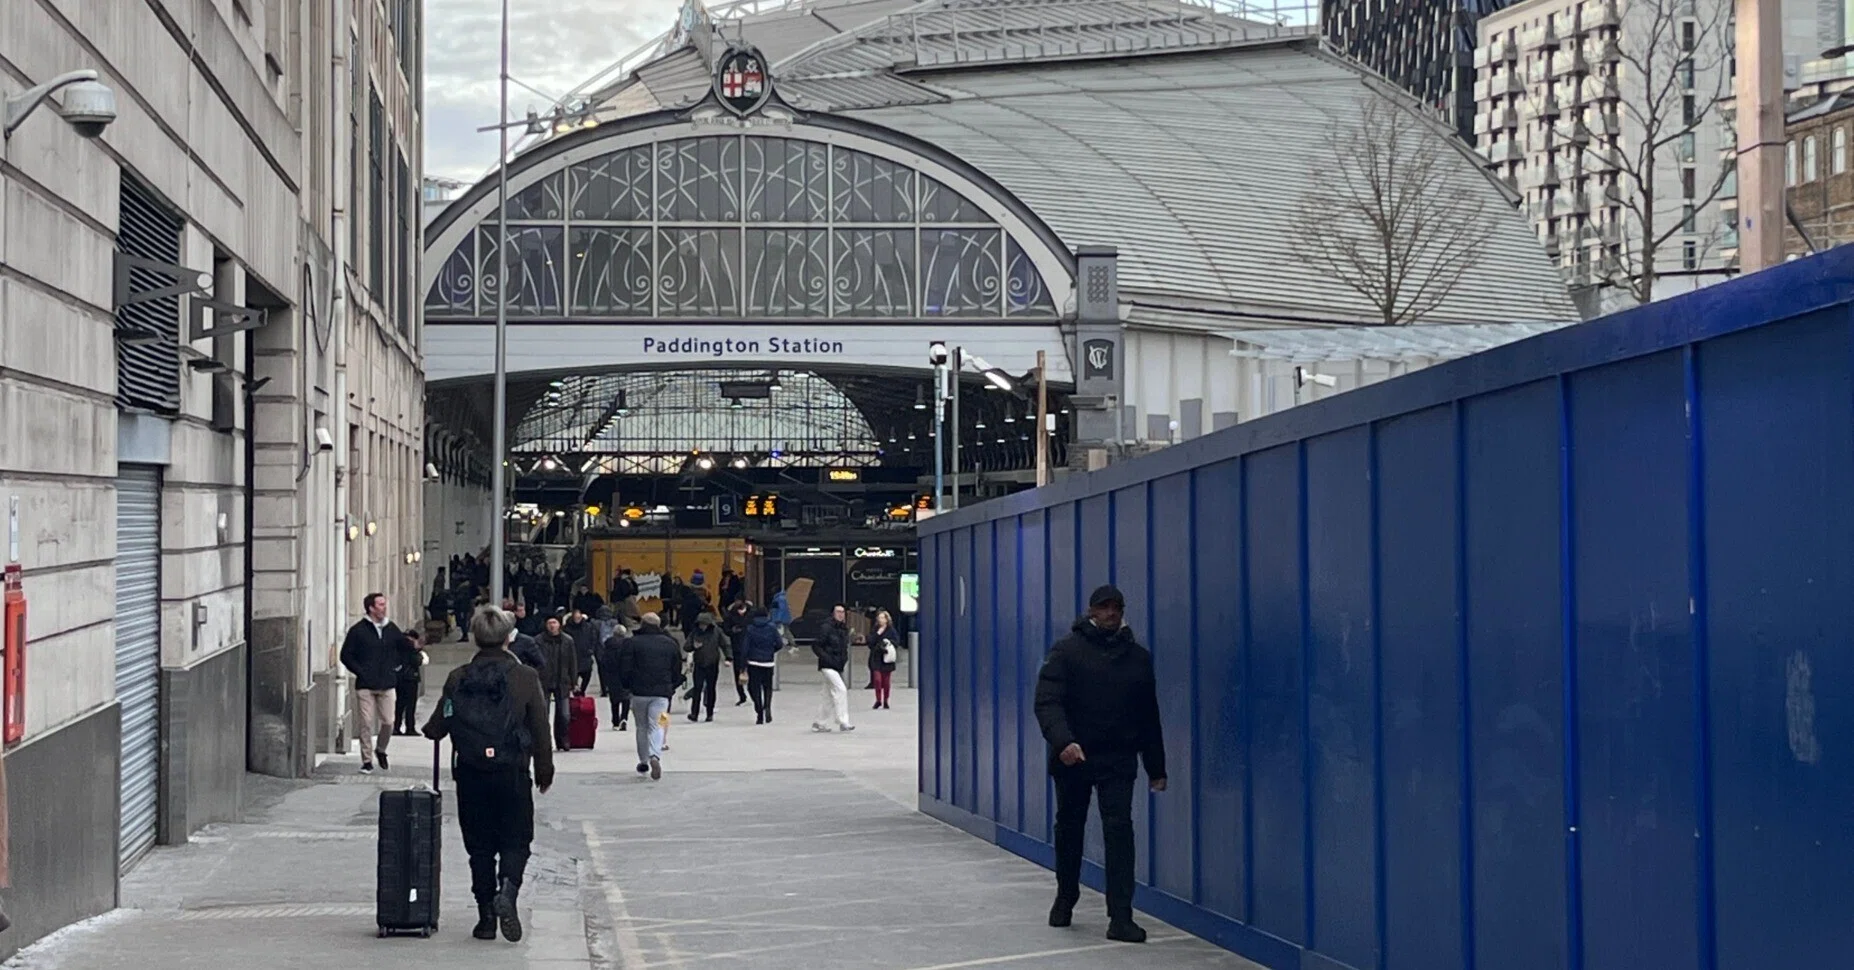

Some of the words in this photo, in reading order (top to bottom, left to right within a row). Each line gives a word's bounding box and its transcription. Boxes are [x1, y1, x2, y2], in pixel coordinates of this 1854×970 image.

[644, 338, 759, 356] Paddington
[768, 337, 844, 353] Station
[722, 504, 732, 516] 9
[854, 547, 895, 558] Chlat
[851, 570, 898, 581] Chlat
